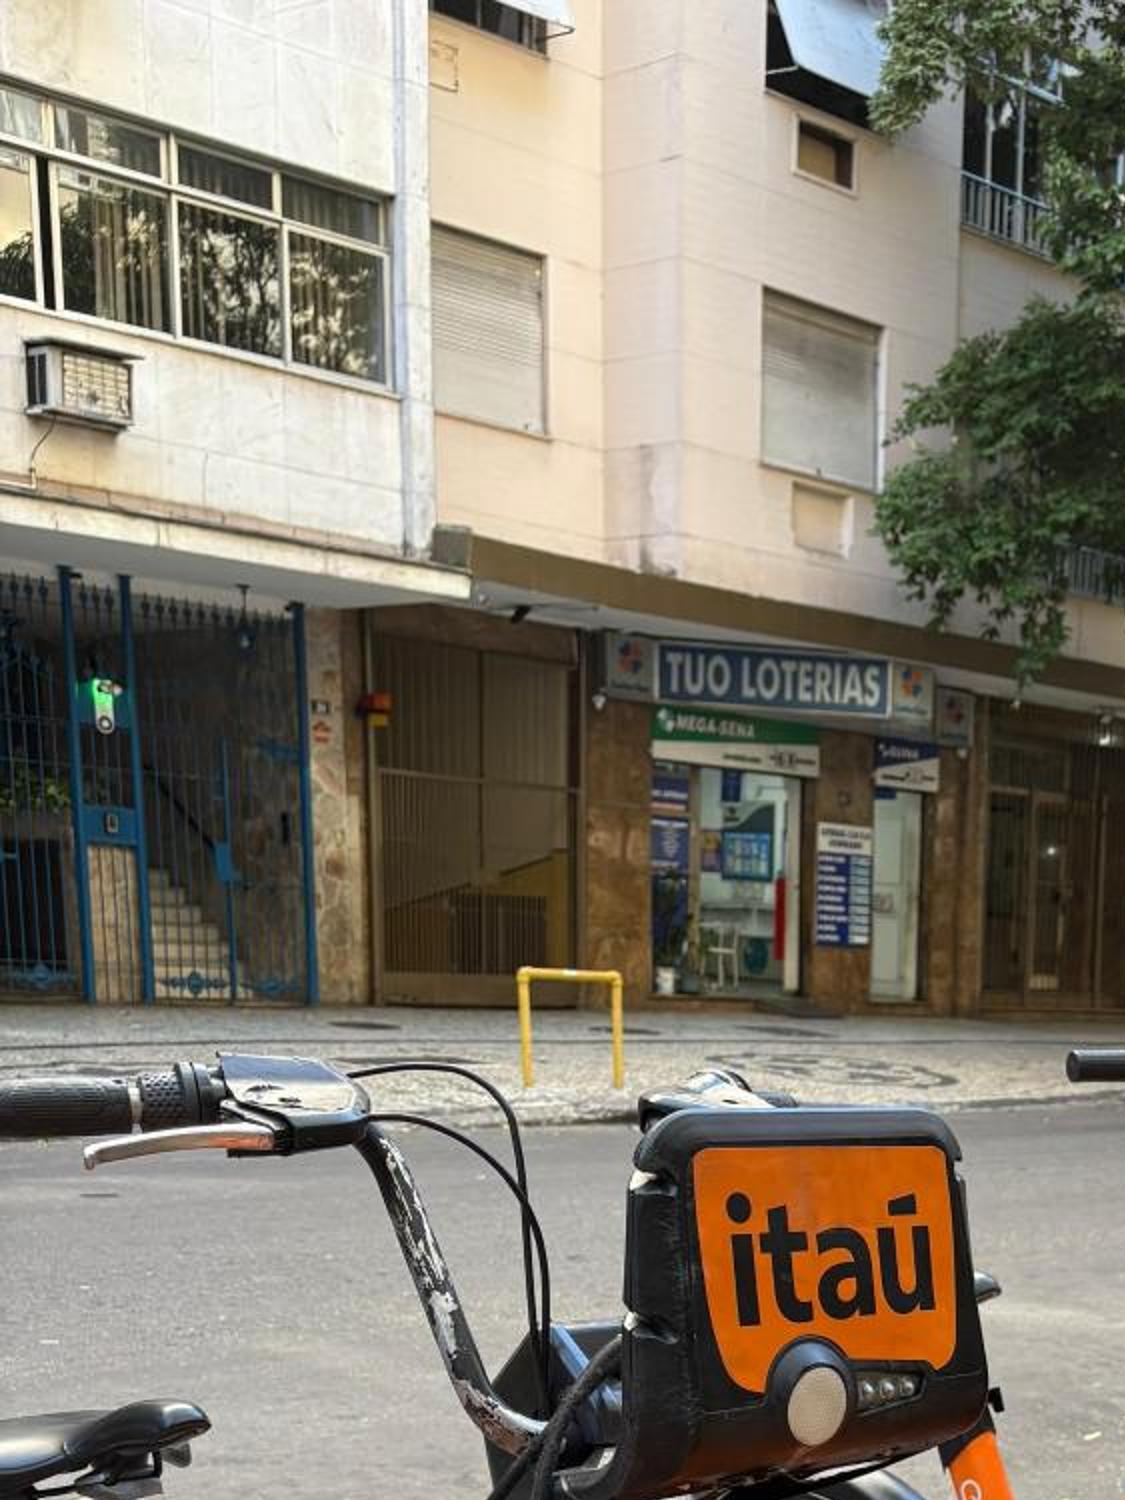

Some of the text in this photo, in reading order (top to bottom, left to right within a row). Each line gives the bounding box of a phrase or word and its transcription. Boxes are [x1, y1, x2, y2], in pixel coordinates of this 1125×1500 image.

[665, 652, 881, 706] TUO LOTERIAS
[725, 1191, 936, 1328] itaú
